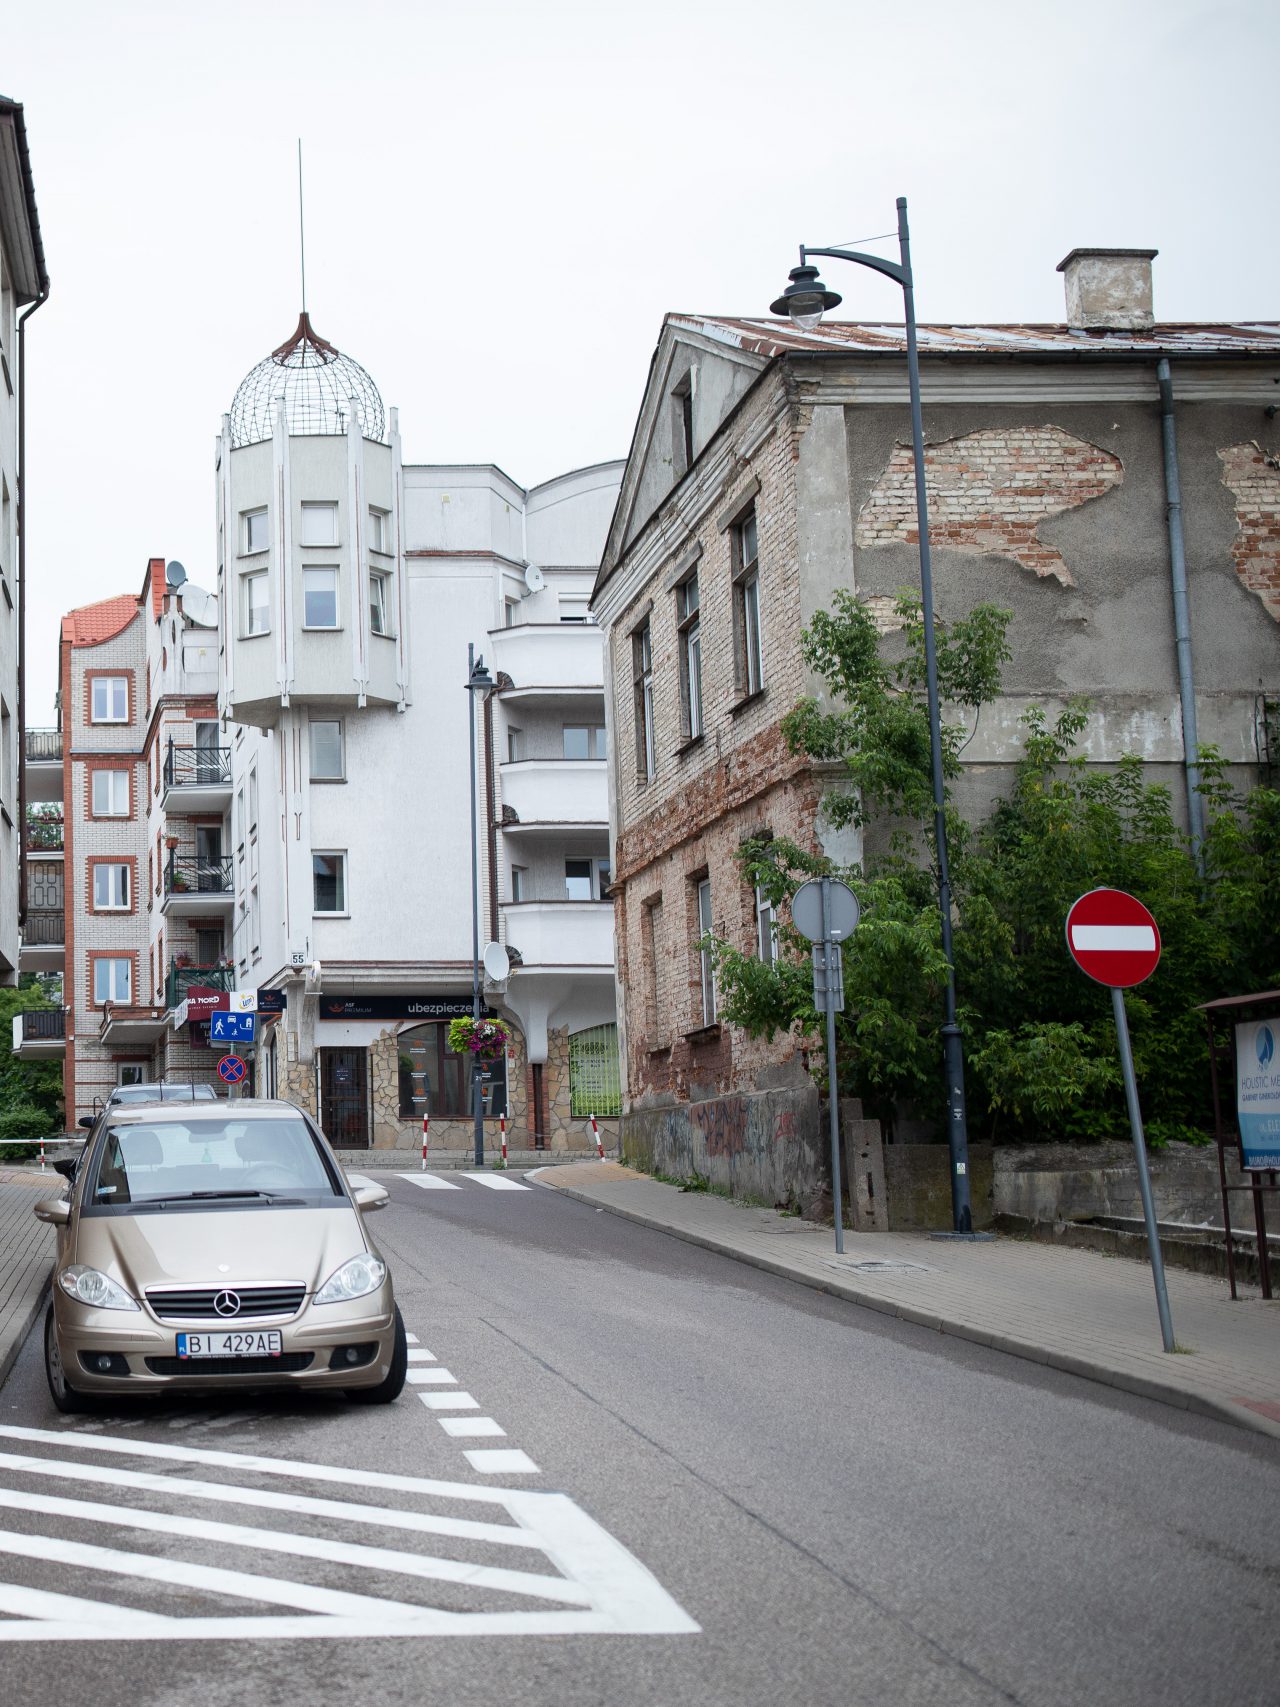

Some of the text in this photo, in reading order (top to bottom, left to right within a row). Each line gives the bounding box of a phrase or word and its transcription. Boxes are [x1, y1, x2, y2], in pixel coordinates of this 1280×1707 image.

[292, 954, 304, 964] 55
[407, 1001, 490, 1015] ubezpieczeia
[189, 1333, 279, 1353] BI 429AE
